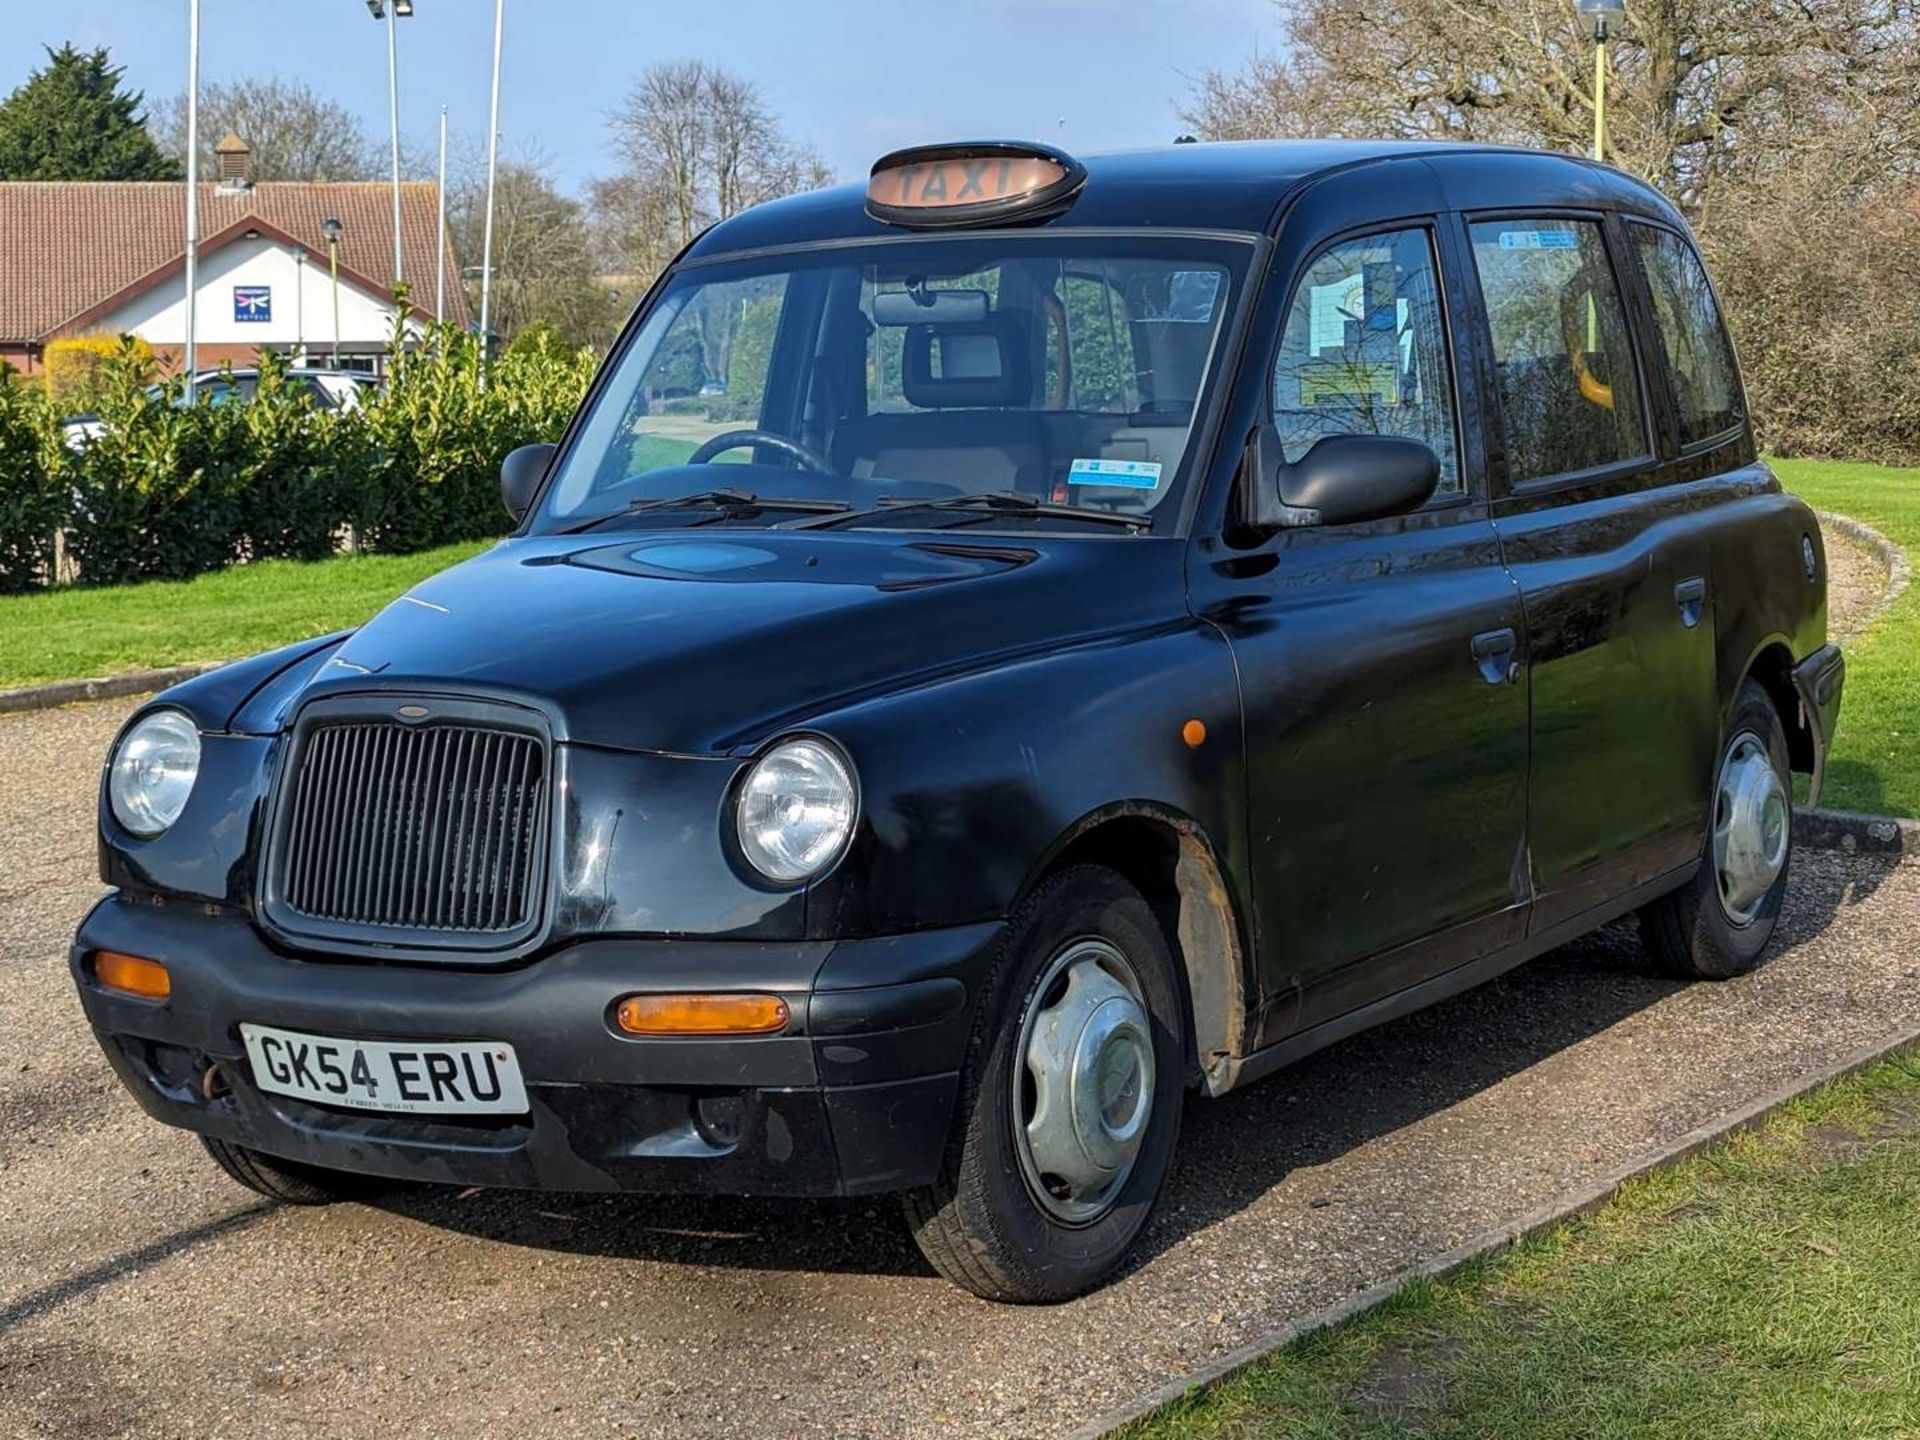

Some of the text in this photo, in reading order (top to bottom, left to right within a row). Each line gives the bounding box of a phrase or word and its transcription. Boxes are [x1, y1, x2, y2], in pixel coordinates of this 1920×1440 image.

[899, 160, 1011, 200] TAXI
[261, 1036, 502, 1102] GK54 ERU
